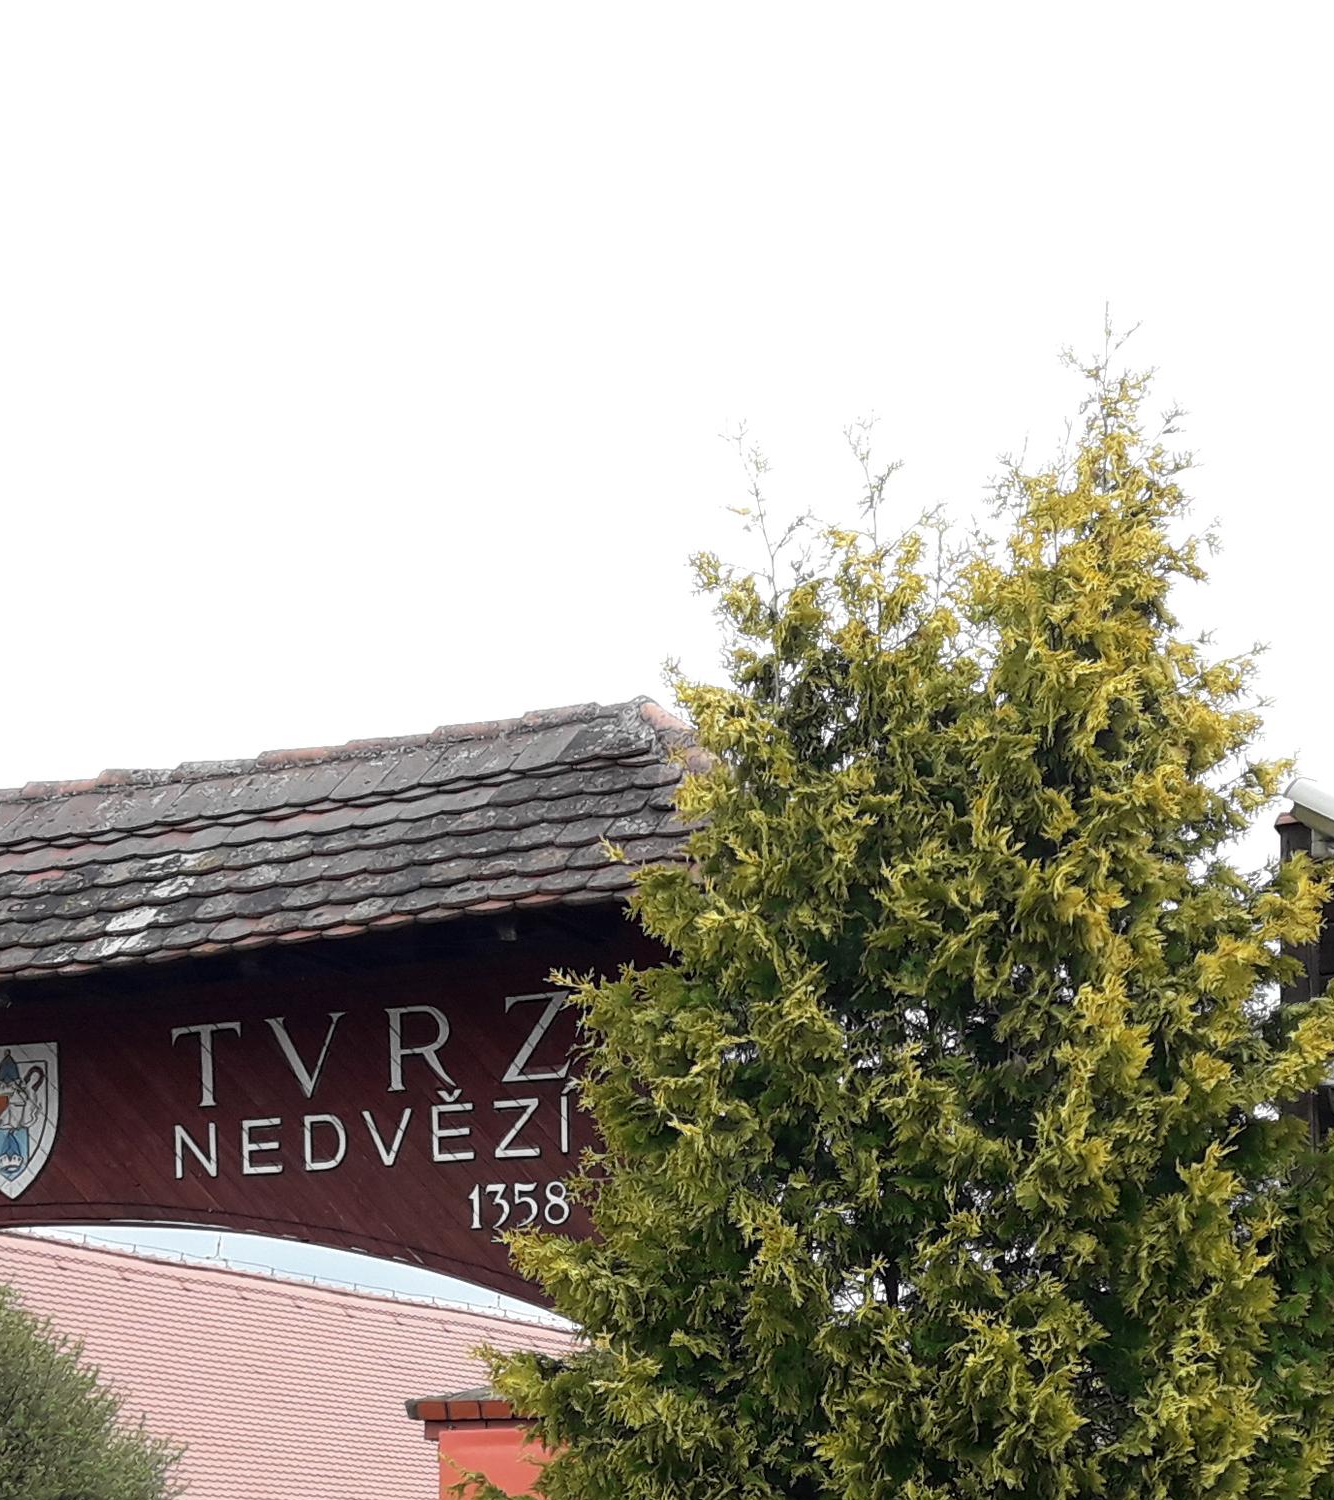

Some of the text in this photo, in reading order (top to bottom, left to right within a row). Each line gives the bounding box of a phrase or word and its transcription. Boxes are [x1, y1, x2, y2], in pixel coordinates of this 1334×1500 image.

[171, 991, 569, 1107] TVRZ
[173, 1088, 570, 1179] NEDVĚZÍ
[468, 1180, 570, 1230] 1358
